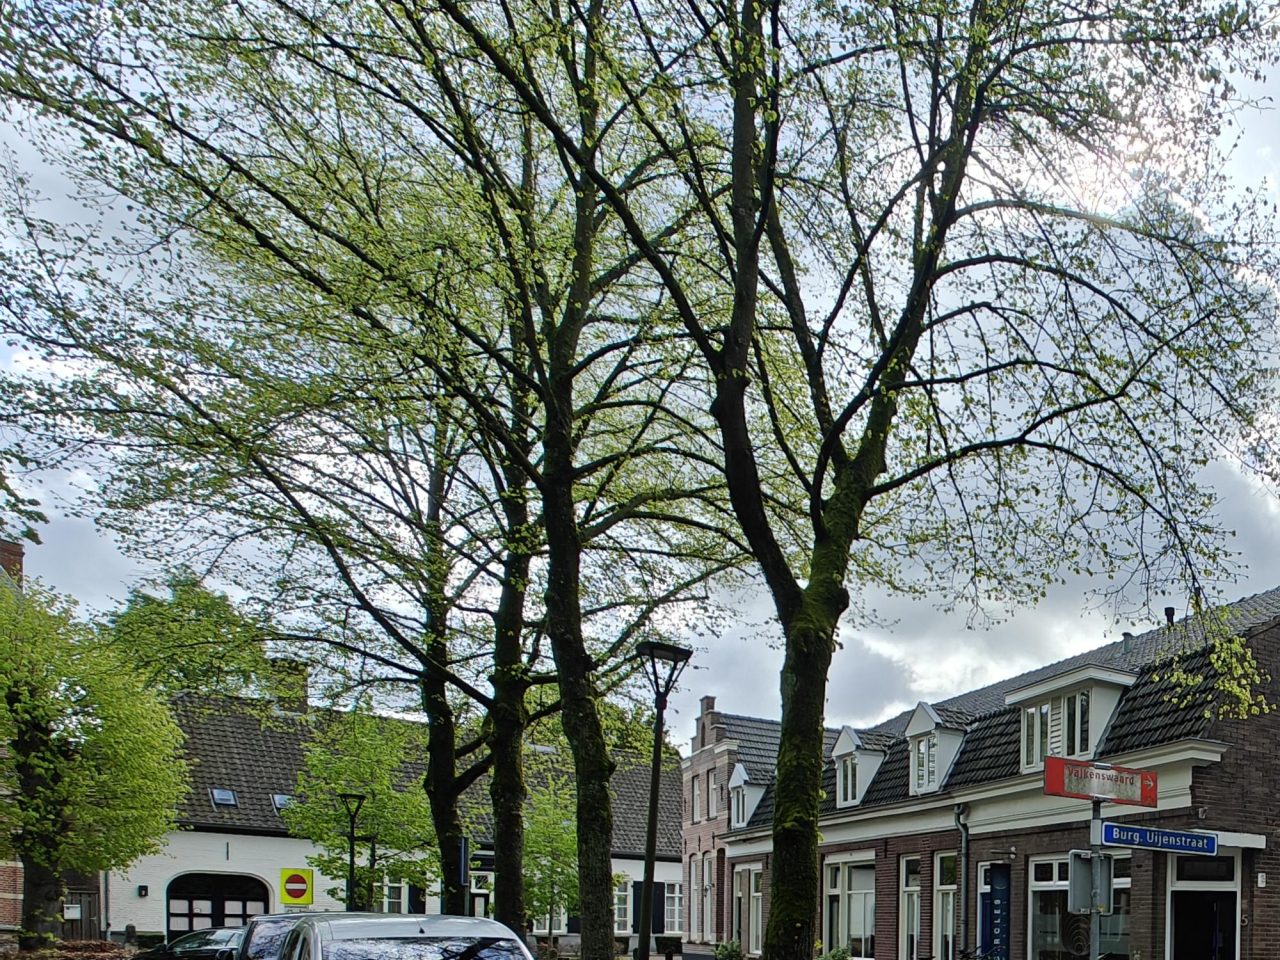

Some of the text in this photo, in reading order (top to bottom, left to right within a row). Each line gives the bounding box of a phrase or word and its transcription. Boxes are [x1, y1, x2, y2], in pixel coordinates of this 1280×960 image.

[1067, 767, 1135, 786] Valkenswaard
[1112, 827, 1208, 848] Burg. Uijenstraat
[1240, 914, 1249, 927] 5
